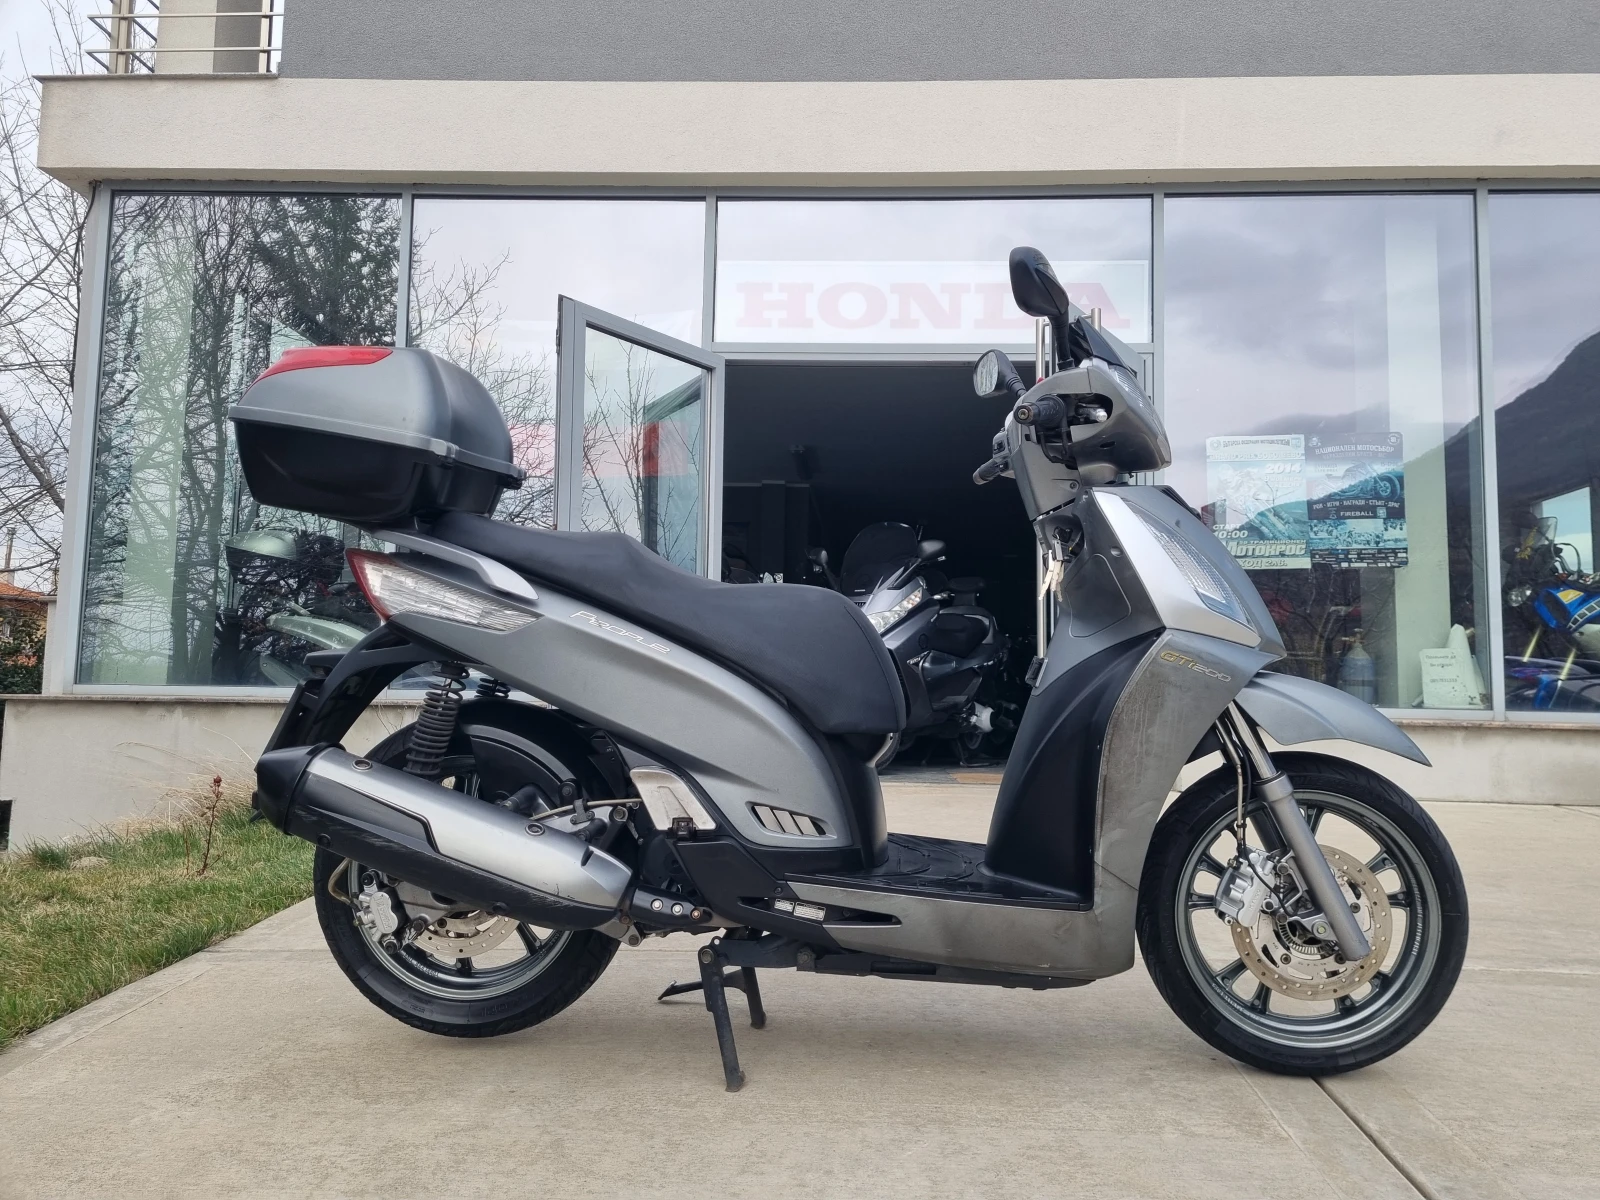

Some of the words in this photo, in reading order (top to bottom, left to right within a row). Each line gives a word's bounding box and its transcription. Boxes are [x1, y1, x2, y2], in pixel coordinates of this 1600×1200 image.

[735, 281, 1131, 330] HONDA
[1315, 445, 1356, 455] НАЦИОНАЛЕН
[1357, 444, 1395, 453] МОТОСЪБОР
[1265, 462, 1303, 474] 2014
[1239, 559, 1263, 568] ХОД
